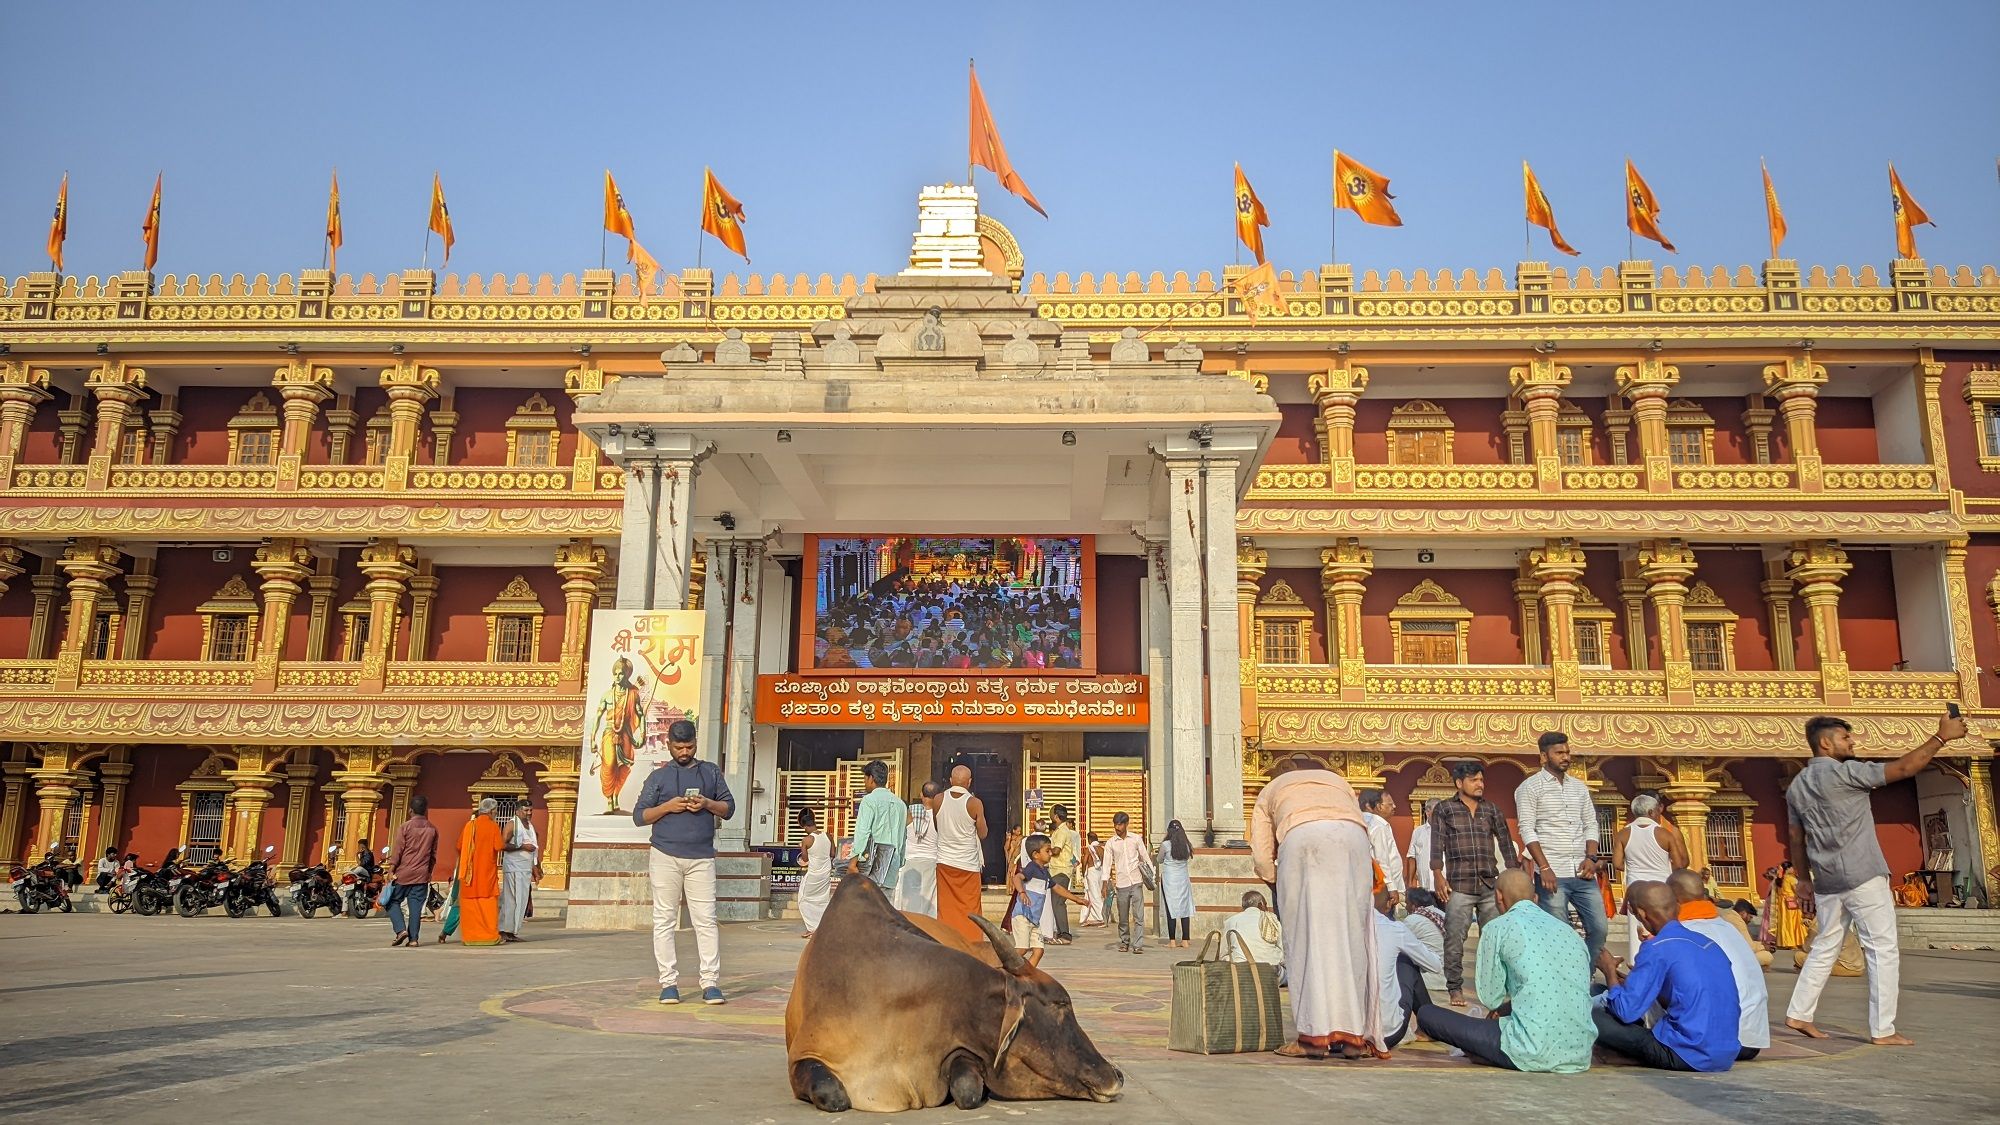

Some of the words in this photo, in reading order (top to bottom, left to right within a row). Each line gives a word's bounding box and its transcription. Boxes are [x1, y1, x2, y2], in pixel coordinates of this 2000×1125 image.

[633, 615, 669, 632] जय
[611, 629, 633, 653] श्री
[634, 635, 699, 685] राम
[774, 678, 850, 700] ಪೂಜ್ಯಾಯ
[856, 678, 969, 698] ರಾಘವೇಂದ್ರಾಯ
[781, 700, 841, 717] ಭಜತಾಂ
[882, 700, 944, 721] ವೃಕ್ಷಾಯ
[951, 700, 1017, 715] ನಮತಾಂ
